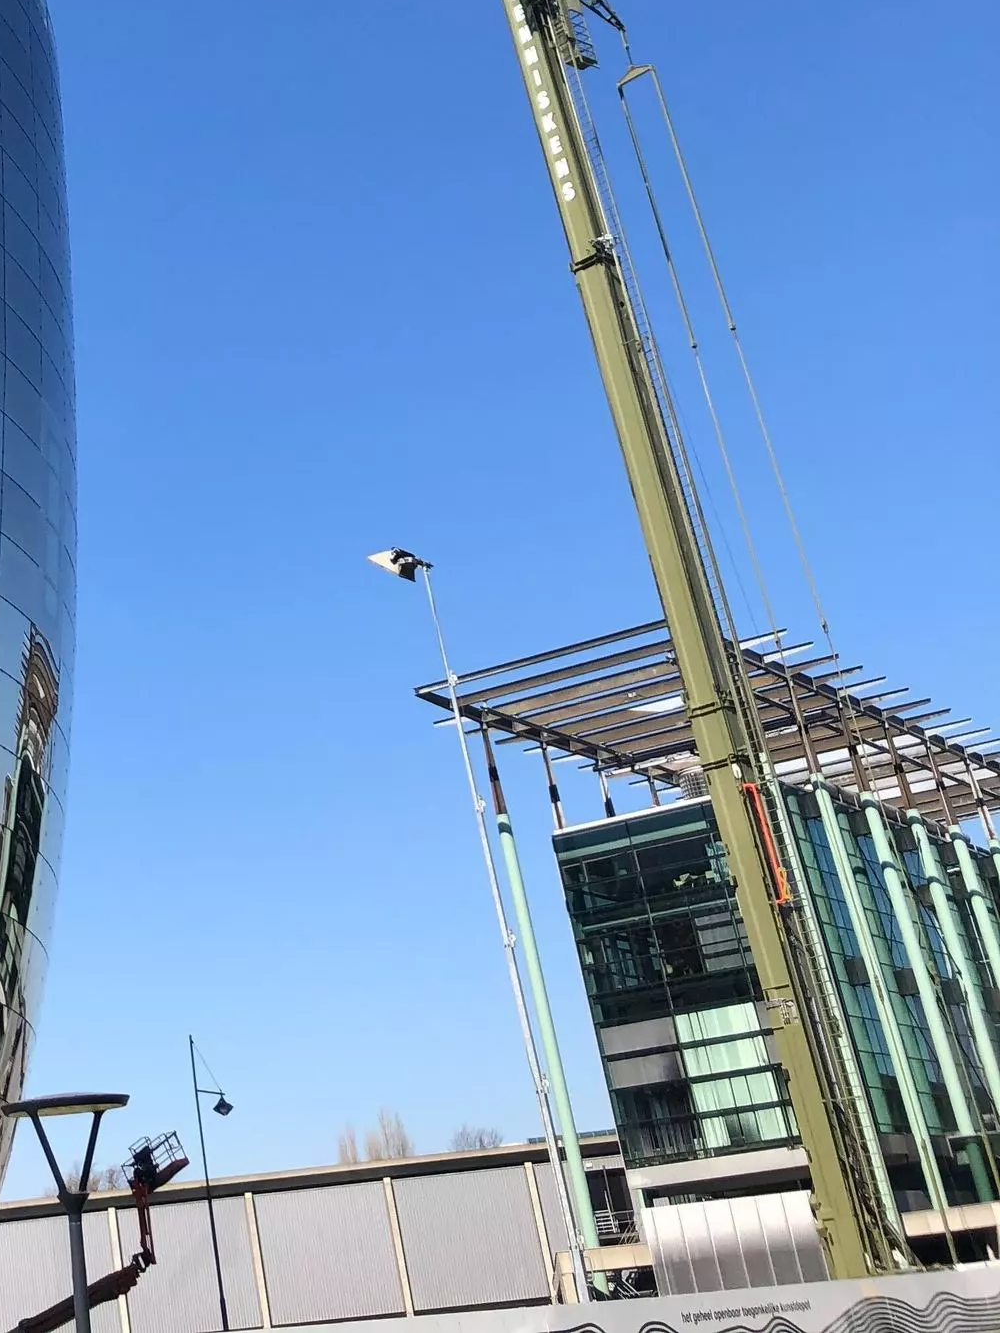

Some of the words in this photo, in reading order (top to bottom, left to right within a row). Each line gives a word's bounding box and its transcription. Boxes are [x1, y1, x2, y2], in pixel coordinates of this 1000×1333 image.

[680, 1311, 693, 1324] het
[692, 1309, 713, 1325] geheel
[713, 1306, 741, 1322] openbaar
